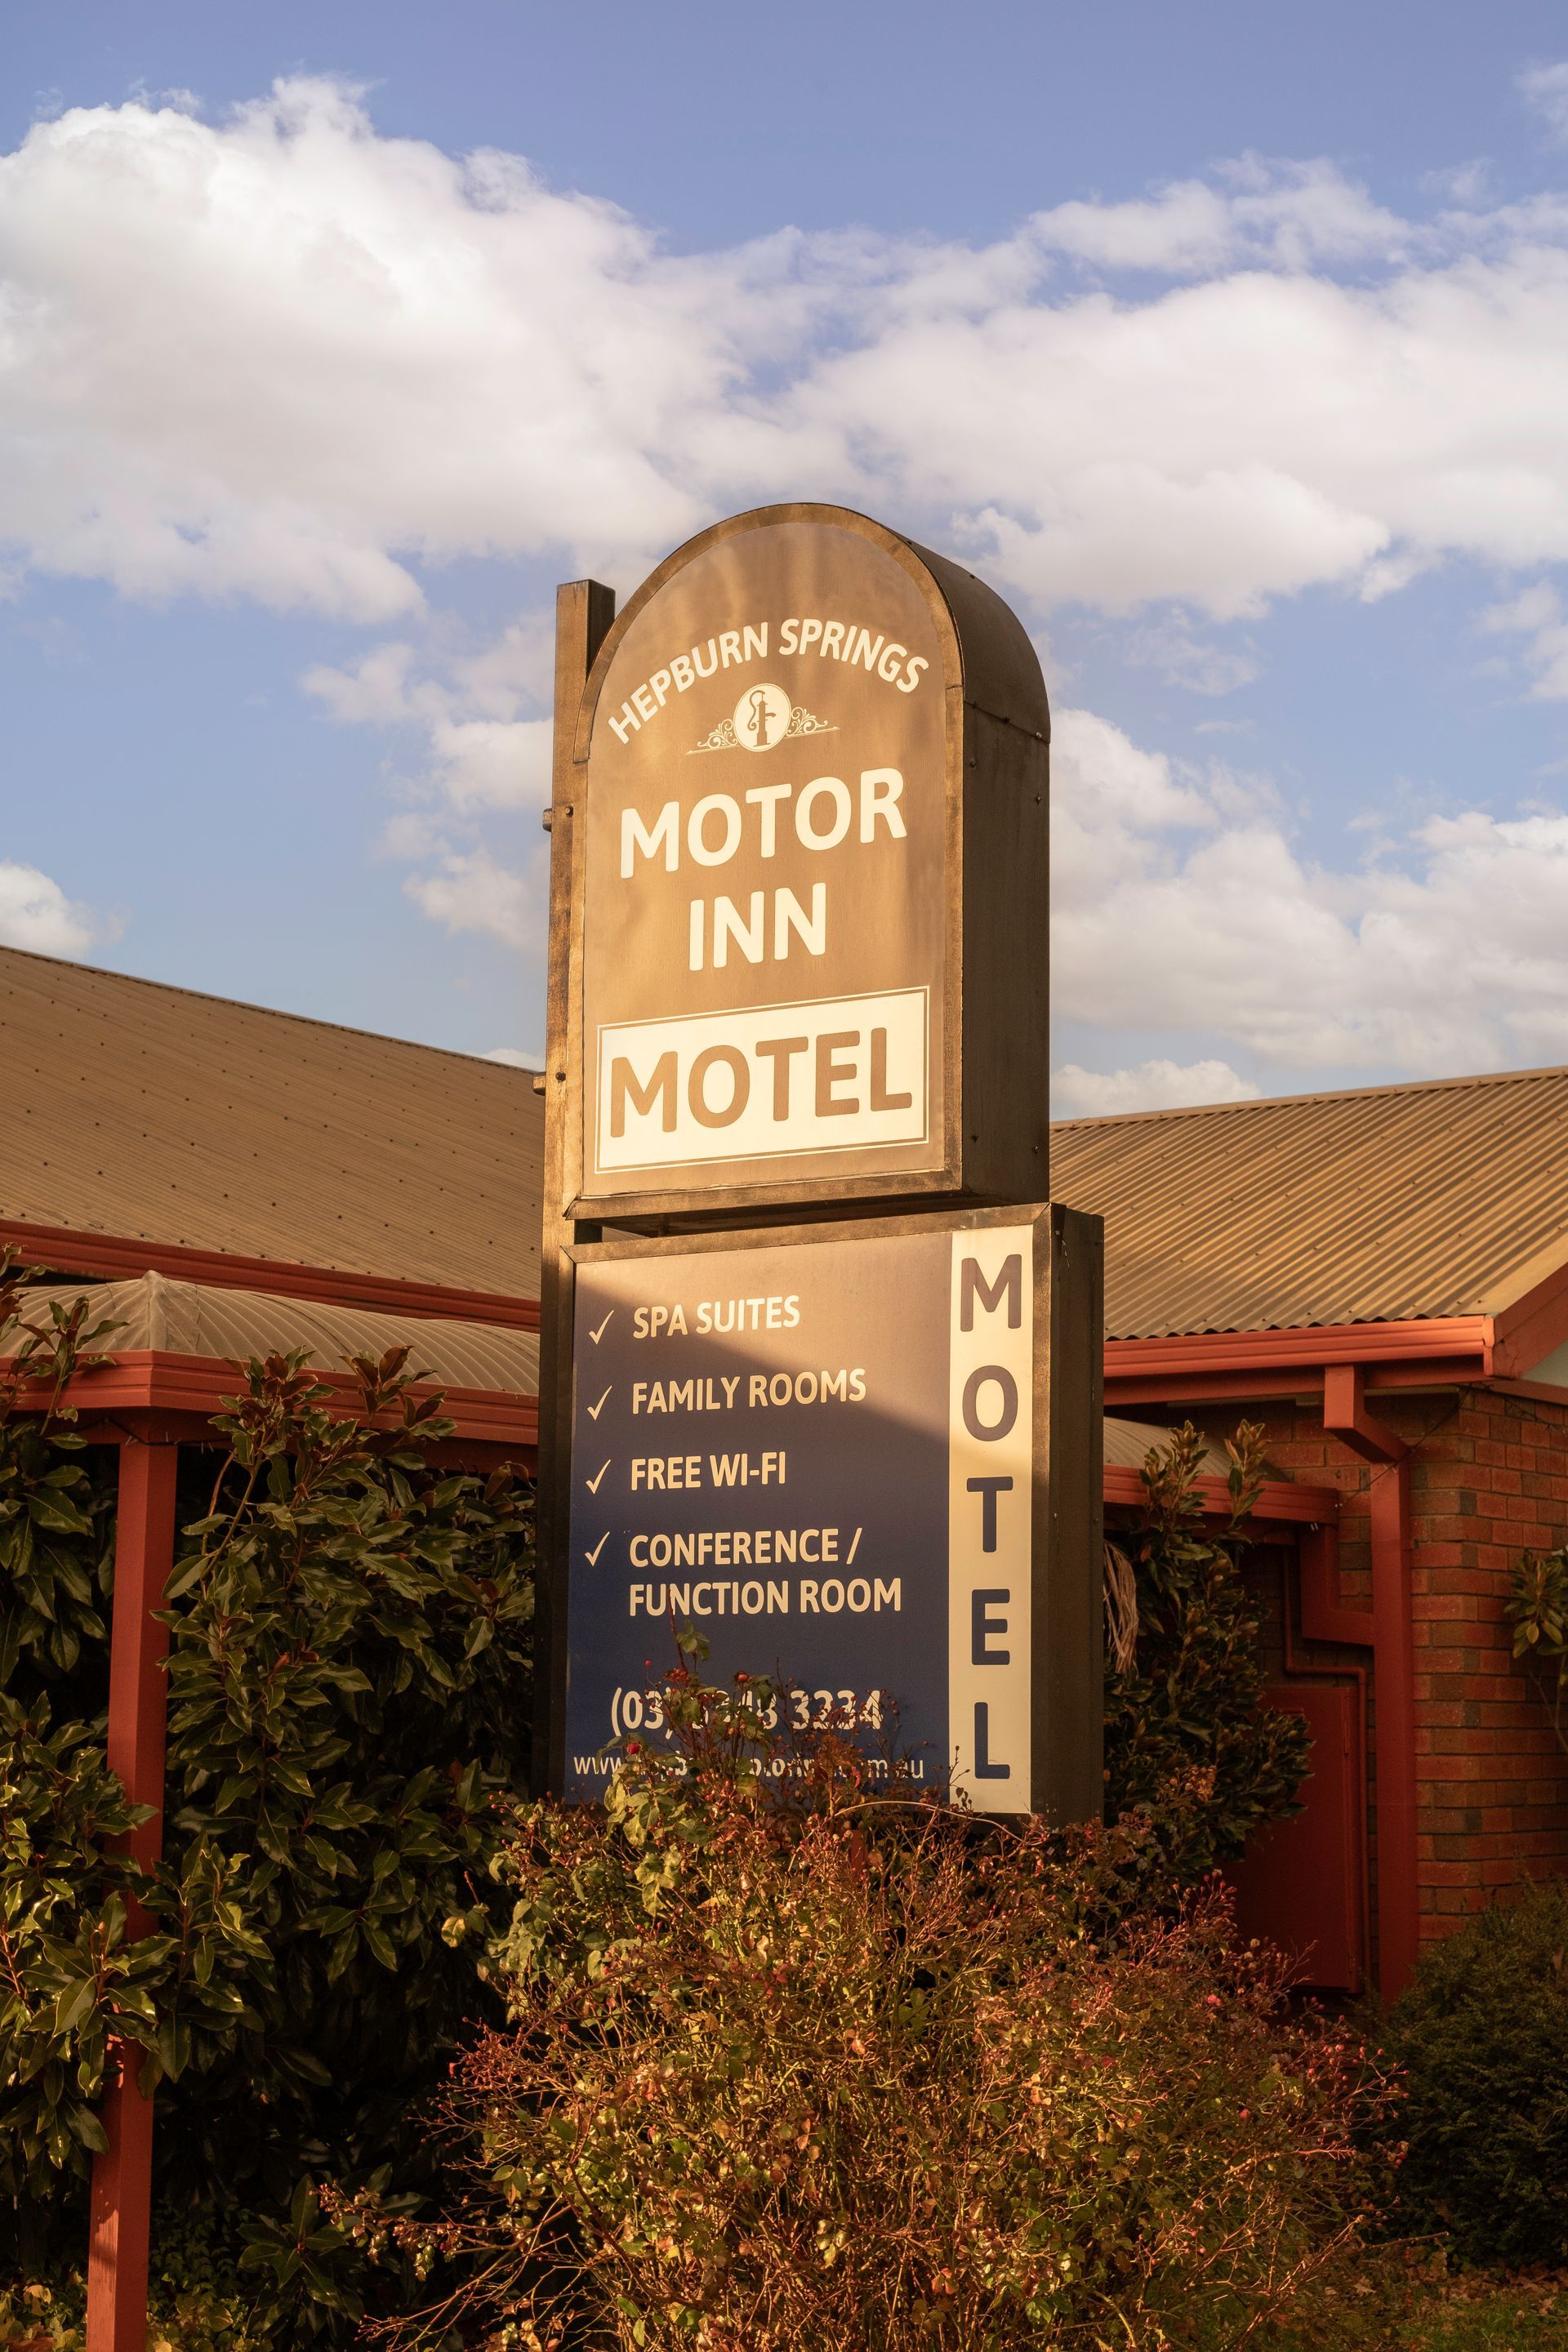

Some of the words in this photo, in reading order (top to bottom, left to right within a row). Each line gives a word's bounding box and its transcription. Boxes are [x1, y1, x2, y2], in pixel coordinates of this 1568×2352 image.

[608, 621, 768, 743] HEPBURN
[779, 618, 929, 694] SPRINGS
[621, 768, 906, 879] MOTOR
[690, 883, 826, 971] INN
[610, 1027, 912, 1138] MOTEL
[632, 1304, 688, 1339] SPA
[697, 1295, 800, 1333] SUITES
[632, 1377, 741, 1414] FAMILY
[749, 1368, 866, 1407] ROOMS
[630, 1456, 702, 1490] FREE
[709, 1451, 786, 1486] WI-FI
[630, 1529, 839, 1567] CONFERENCE
[960, 1254, 1022, 1780] MOTEL
[630, 1581, 788, 1616] FUNCTION
[800, 1578, 901, 1613] ROOM
